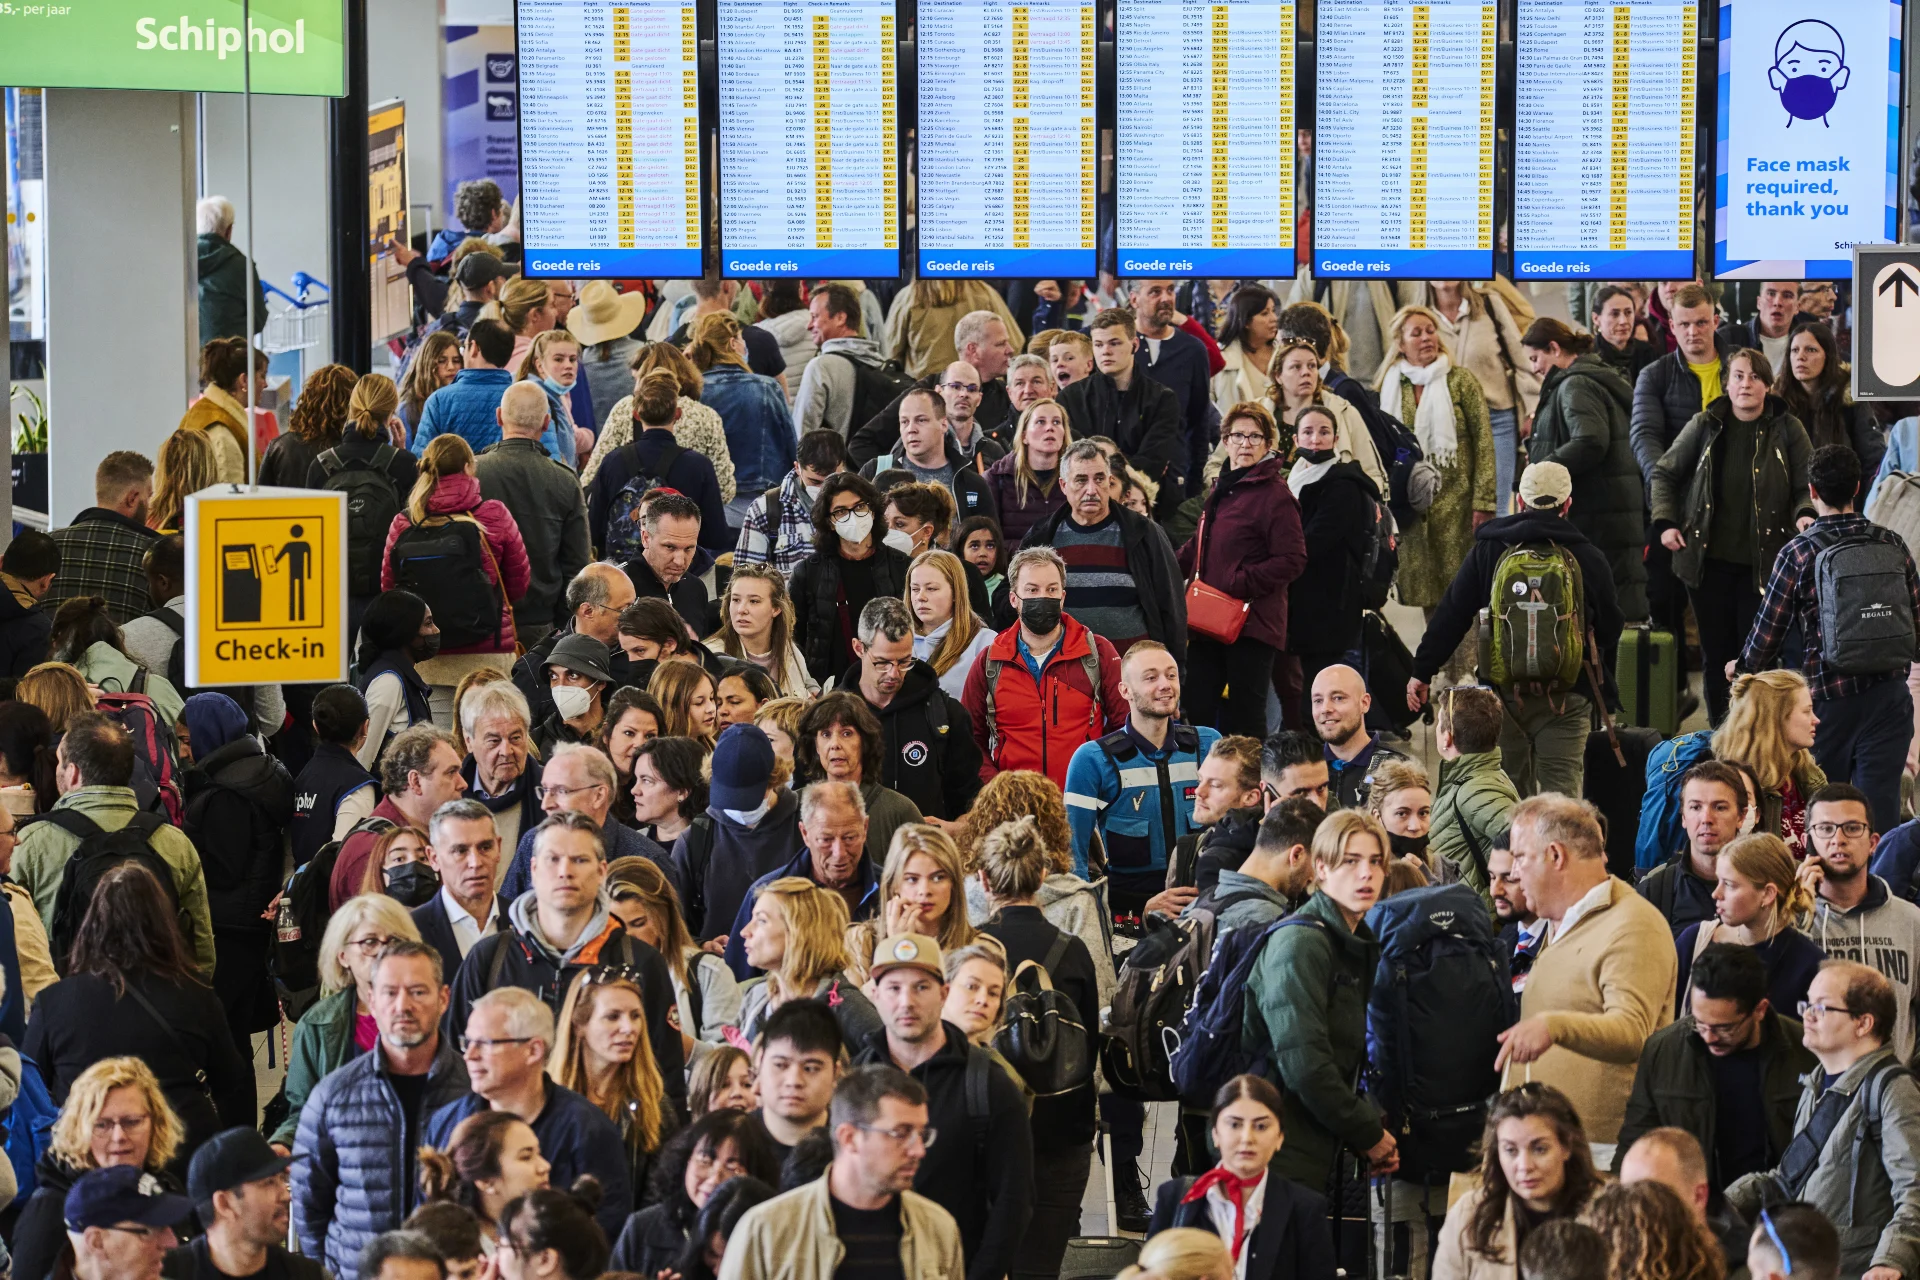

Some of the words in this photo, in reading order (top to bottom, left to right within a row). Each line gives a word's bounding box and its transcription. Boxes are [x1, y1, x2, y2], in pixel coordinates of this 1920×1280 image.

[23, 5, 45, 17] per
[46, 4, 71, 17] jaar
[135, 15, 305, 60] Schiphol
[1747, 158, 1791, 172] Face
[1796, 156, 1850, 172] mask
[1746, 179, 1839, 198] required,
[1746, 201, 1805, 216] thank
[1810, 205, 1848, 219] you
[532, 259, 574, 271] Goede
[577, 262, 601, 271] reis
[730, 260, 772, 271] Goede
[774, 263, 798, 271] reis
[926, 260, 969, 271] Goede
[971, 263, 995, 271] reis
[1124, 259, 1167, 271] Goede
[1169, 262, 1193, 271] reis
[1321, 260, 1364, 271] Goede
[1367, 263, 1391, 272] reis
[1521, 261, 1564, 273] Goede
[1567, 264, 1591, 273] reis
[1861, 610, 1893, 619] REGALIS
[215, 637, 325, 661] Check-in
